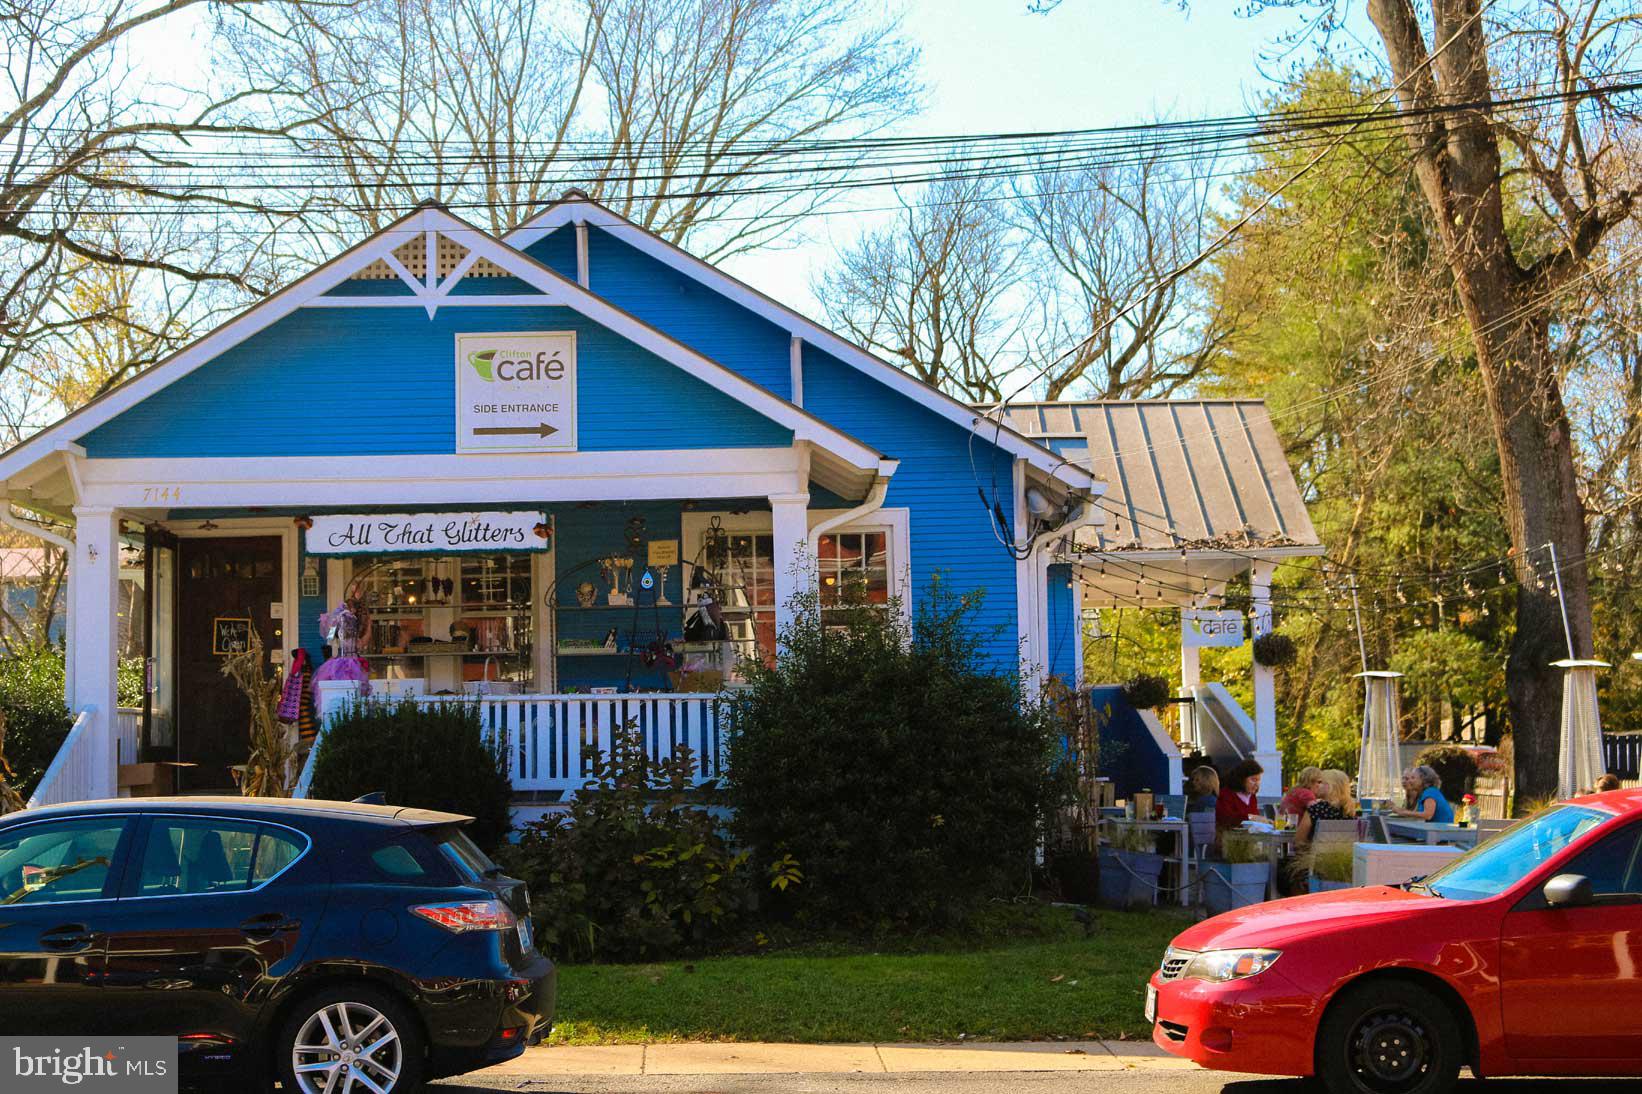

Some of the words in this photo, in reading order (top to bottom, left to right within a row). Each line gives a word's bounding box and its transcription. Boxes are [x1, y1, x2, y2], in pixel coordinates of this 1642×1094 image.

[500, 350, 531, 358] Clifton
[497, 351, 564, 381] café
[473, 404, 498, 413] SIDE
[501, 403, 559, 413] ENTRANCE
[144, 487, 181, 503] 7144
[328, 523, 372, 547] All
[378, 522, 434, 545] That
[441, 521, 525, 545] Glitters
